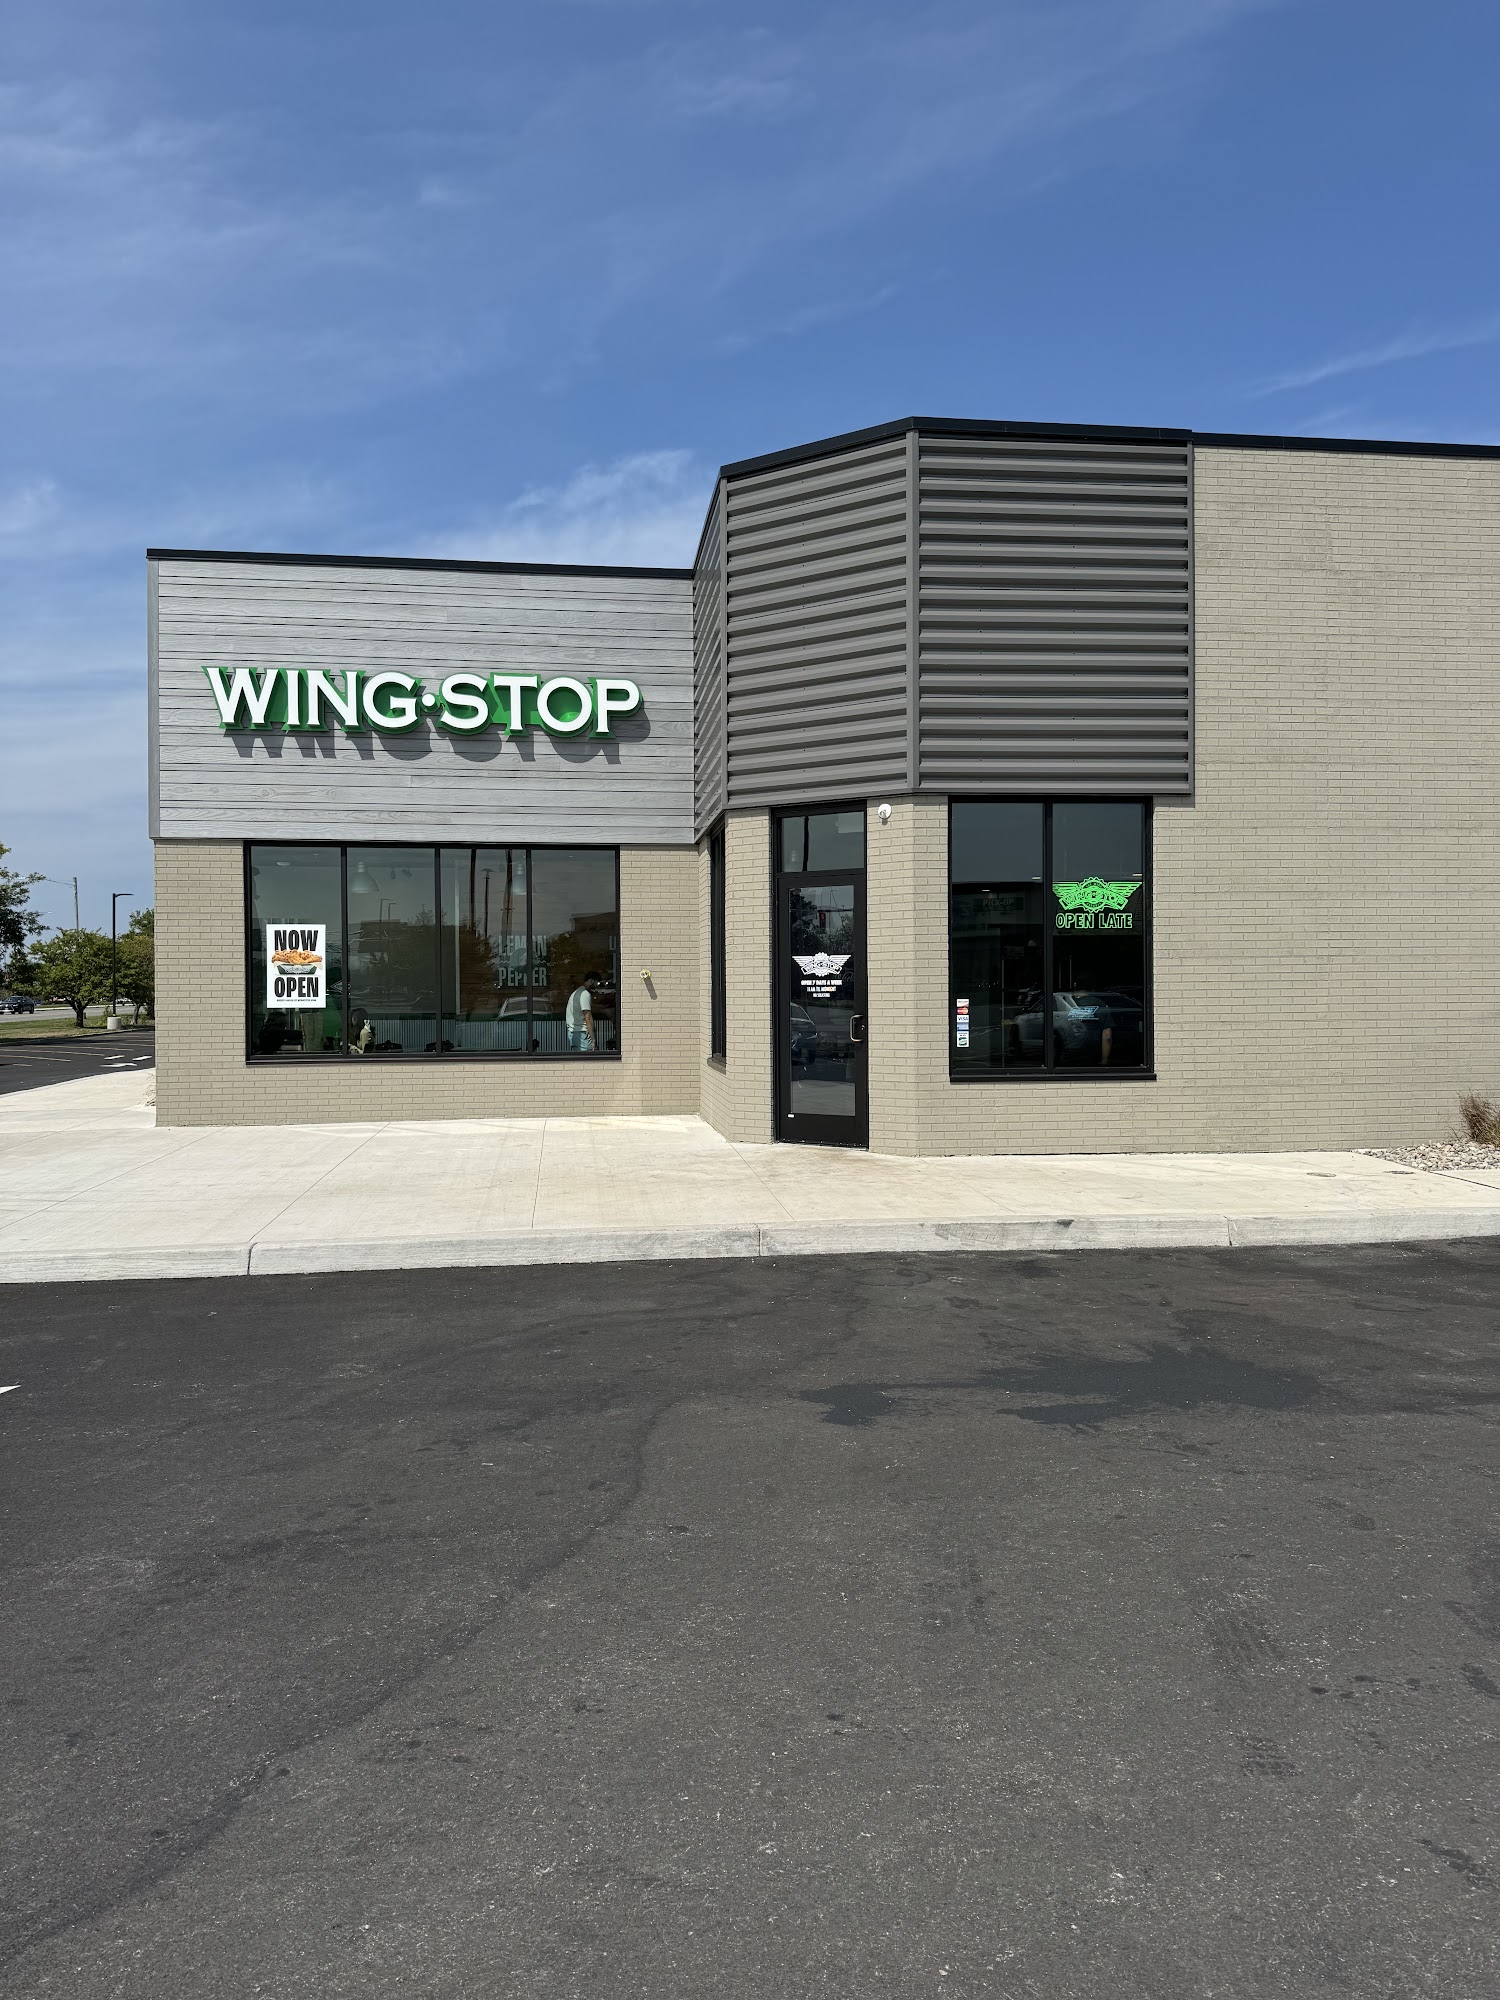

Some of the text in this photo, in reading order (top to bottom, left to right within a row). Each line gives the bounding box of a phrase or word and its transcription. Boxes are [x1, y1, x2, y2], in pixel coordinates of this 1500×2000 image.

[1055, 913, 1133, 928] OPEN LATE
[274, 930, 318, 951] NOW
[274, 977, 318, 997] OPEN
